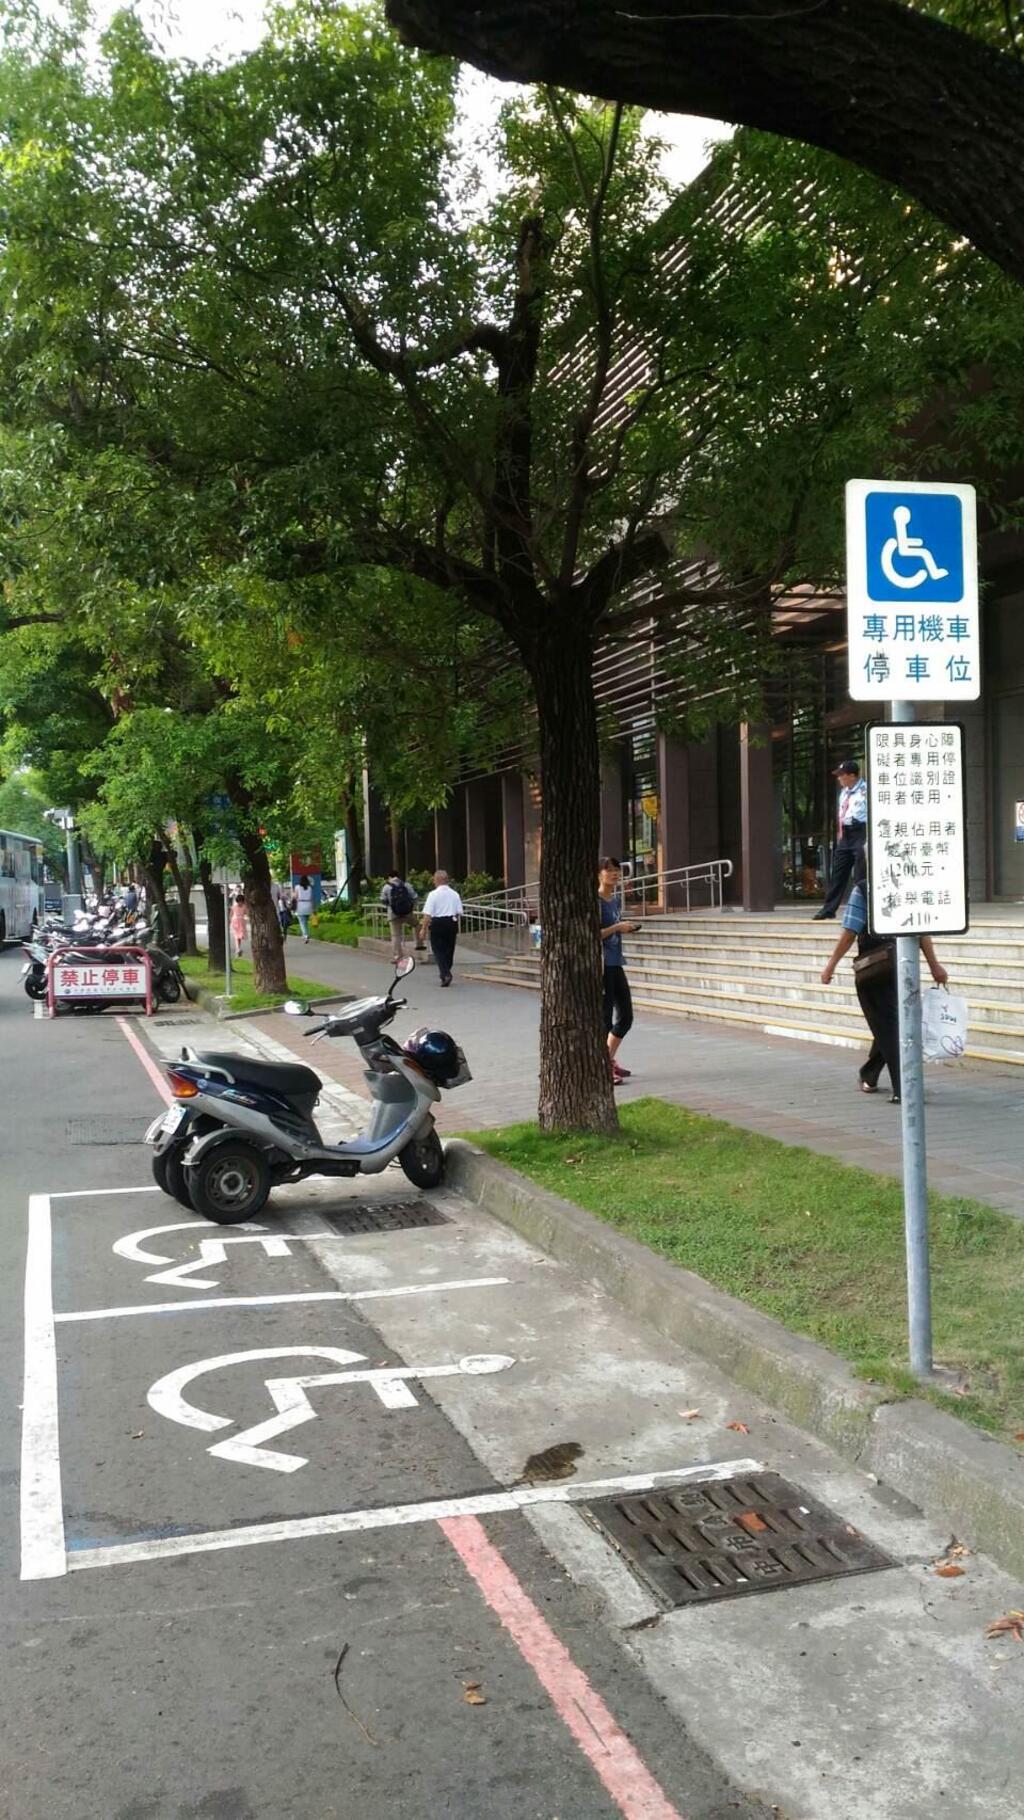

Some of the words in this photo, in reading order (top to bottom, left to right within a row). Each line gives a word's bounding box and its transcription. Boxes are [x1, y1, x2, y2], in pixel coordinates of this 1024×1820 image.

[863, 614, 970, 642] 專用機車
[864, 653, 972, 683] 停車位
[876, 732, 954, 749] 限具身心障
[878, 770, 956, 787] 車位識別證
[60, 968, 139, 987] 禁止停車
